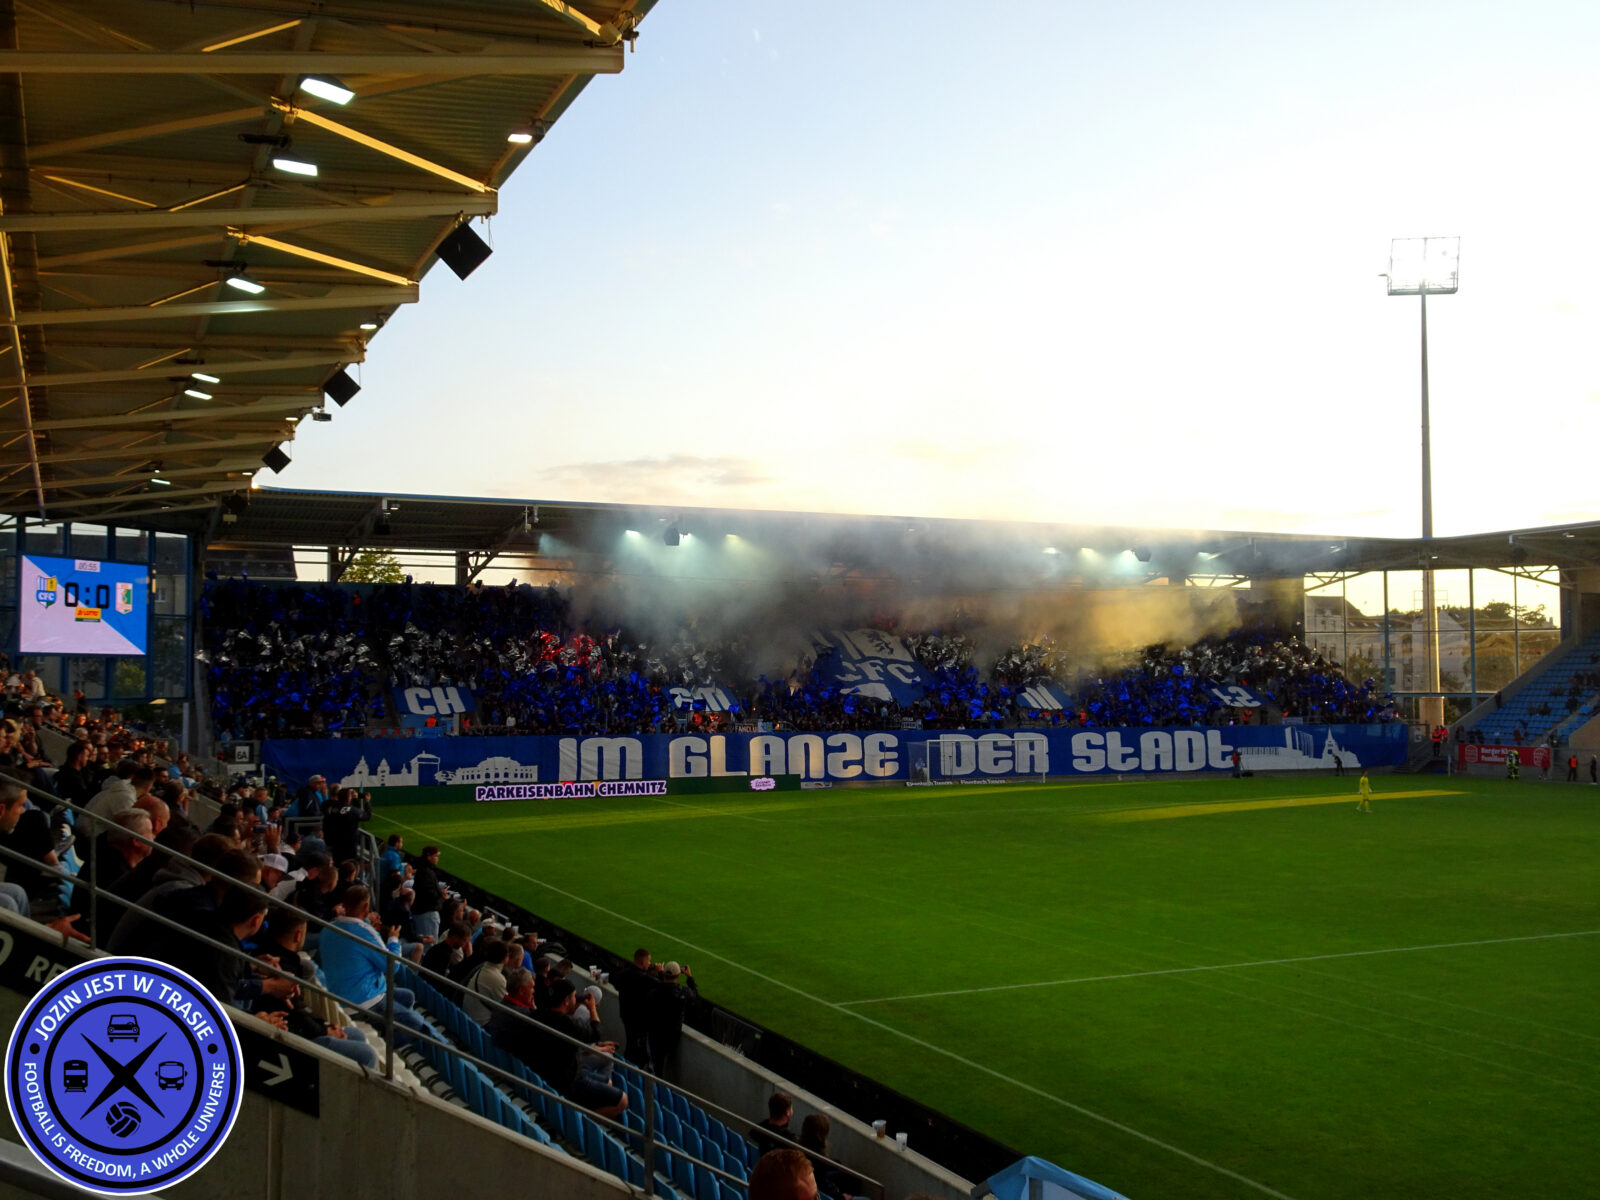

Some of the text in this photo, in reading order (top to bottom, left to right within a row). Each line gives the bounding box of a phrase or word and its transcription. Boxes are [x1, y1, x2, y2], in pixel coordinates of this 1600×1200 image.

[38, 592, 54, 601] CFC
[65, 582, 109, 609] 0:0
[404, 686, 466, 715] CH
[558, 736, 643, 780] IM
[940, 733, 1049, 776] DER
[476, 781, 666, 801] PARKEISENBAHN CHEMNITZ
